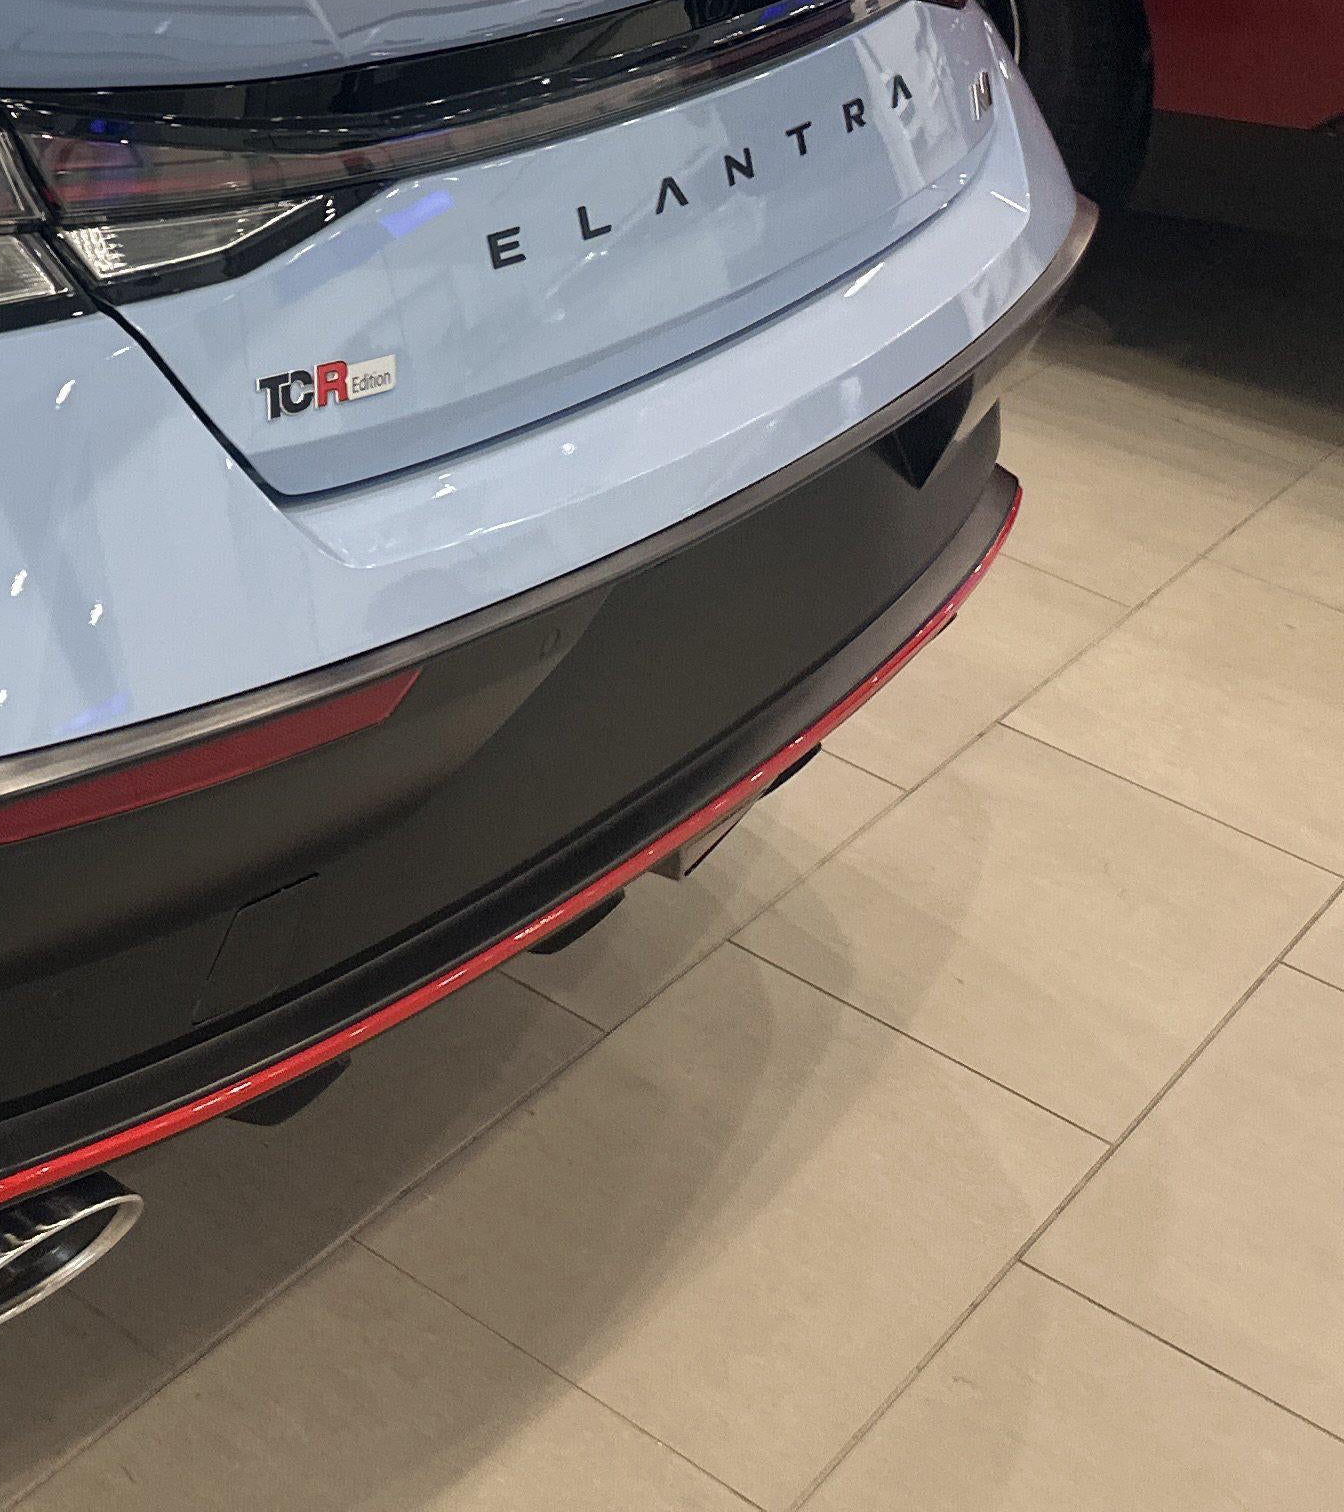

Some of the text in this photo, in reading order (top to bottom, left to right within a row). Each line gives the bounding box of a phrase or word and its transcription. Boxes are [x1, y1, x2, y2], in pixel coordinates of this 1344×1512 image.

[487, 74, 913, 269] ELANTRA
[256, 360, 392, 421] TCR Edition
